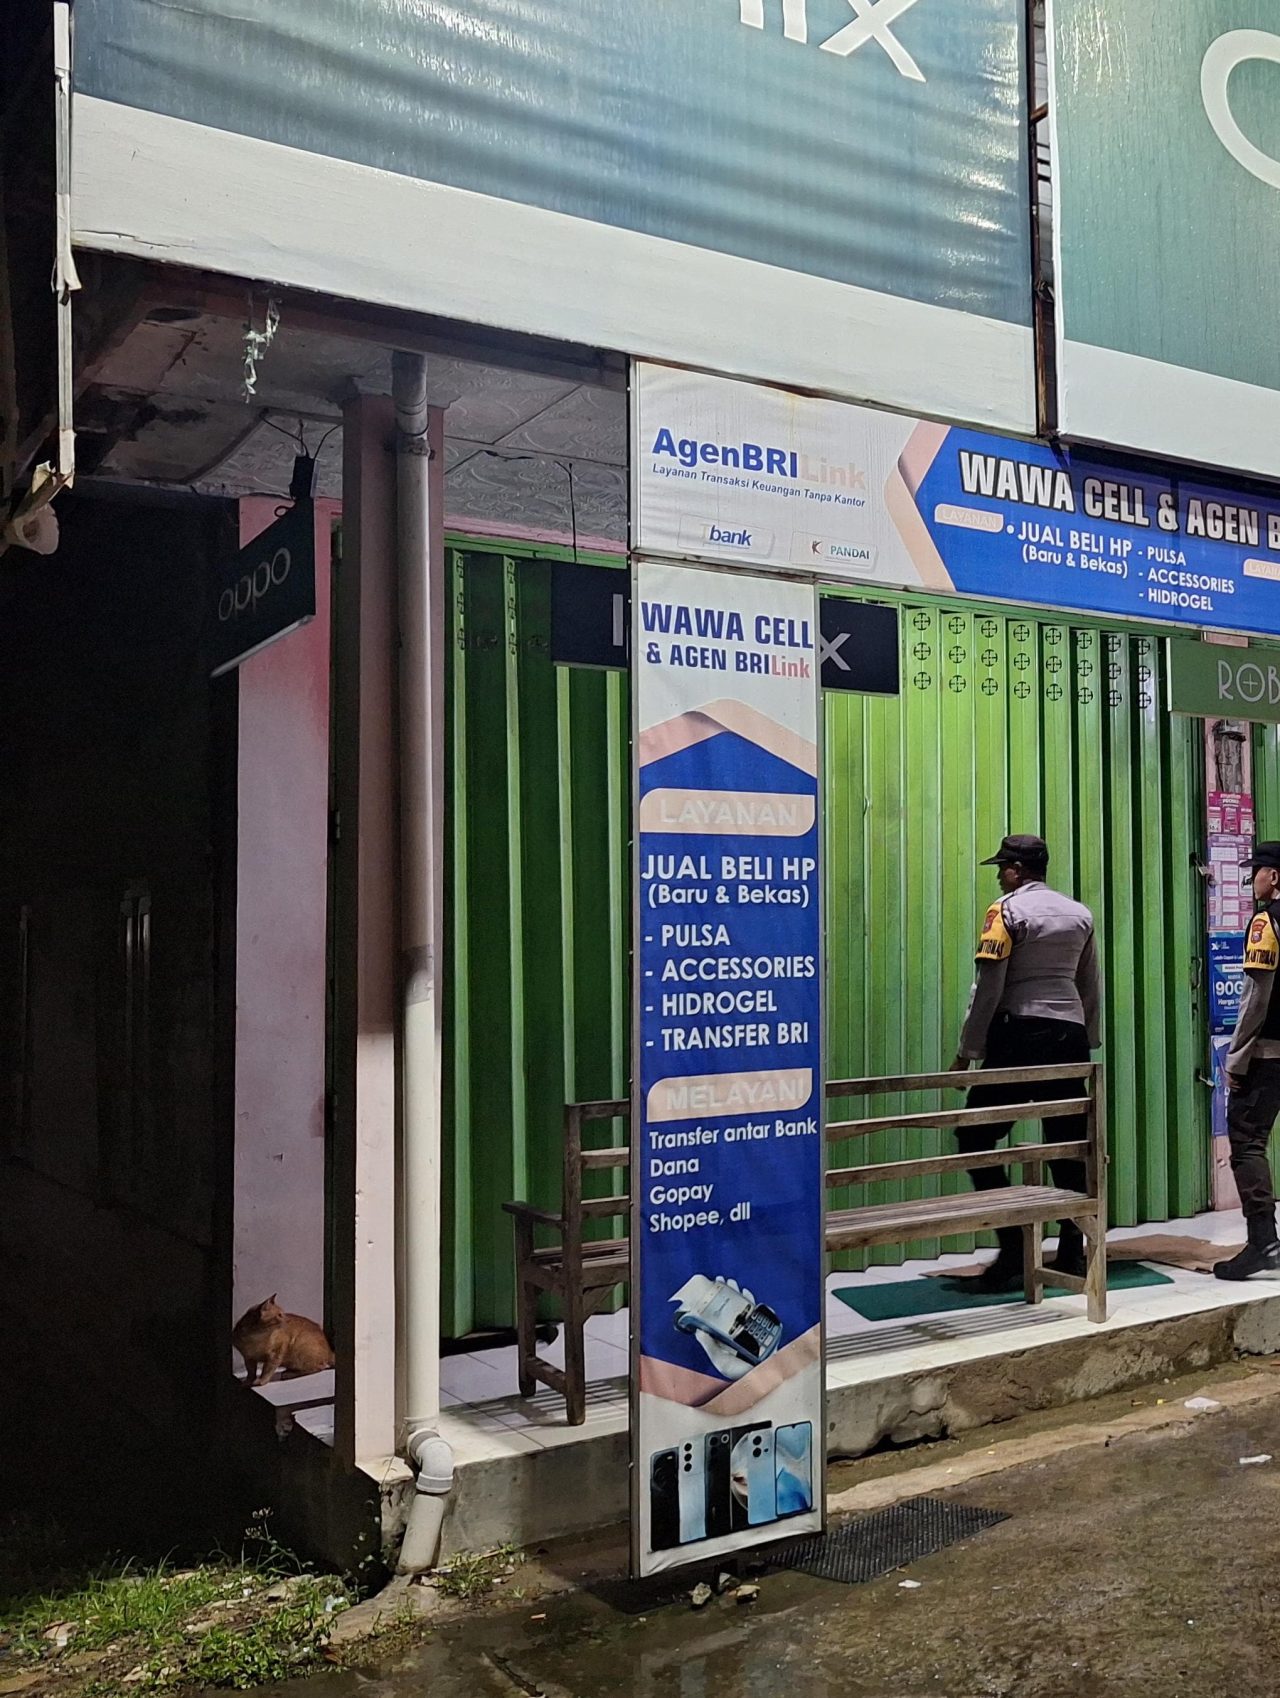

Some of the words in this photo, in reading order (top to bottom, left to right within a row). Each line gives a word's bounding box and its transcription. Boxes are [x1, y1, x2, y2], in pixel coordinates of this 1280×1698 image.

[652, 463, 697, 479] Layanan
[701, 471, 750, 488] Transaksi
[752, 480, 801, 498] Keuangan
[803, 489, 832, 503] Tanpa
[834, 494, 866, 508] Kantor
[959, 450, 1076, 513] WAWA
[1083, 476, 1150, 528] CELL
[1156, 491, 1180, 533] &
[1186, 498, 1259, 546] AGEN
[941, 507, 997, 529] LAYANAN
[830, 545, 870, 560] PANDAI
[1018, 521, 1064, 547] JUAL
[1069, 530, 1104, 554] BELI
[1109, 537, 1133, 558] HP
[1022, 544, 1062, 564] (Baru
[1066, 552, 1076, 568] &
[1080, 554, 1129, 579] Bekas)
[1147, 546, 1186, 567] PULSA
[218, 547, 291, 621] oppo
[1148, 567, 1235, 594] ACCESSORIES
[1148, 587, 1214, 611] HIDROGEL
[641, 602, 745, 642] WAWA
[754, 613, 814, 649] CELL
[646, 642, 662, 665] &
[670, 644, 727, 671] AGEN
[735, 650, 810, 679] BRILink
[660, 799, 798, 826] LAYANAN
[641, 855, 712, 880] JUAL
[721, 856, 773, 880] BELI
[782, 857, 816, 880] HP
[648, 883, 708, 909] (Baru
[715, 885, 730, 904] &
[738, 884, 809, 908] Bekas)
[661, 924, 731, 947] PULSA
[661, 955, 815, 982] ACCESSORIES
[662, 990, 777, 1017] HIDROGEL
[661, 1023, 770, 1052] TRANSFER
[777, 1021, 808, 1045] BRI
[666, 1078, 804, 1111] MELAYANI
[649, 1126, 720, 1150] Transfer
[724, 1122, 771, 1142] antar
[775, 1117, 817, 1138] Bank
[650, 1158, 700, 1178] Dana
[650, 1184, 714, 1206] Gopay
[649, 1209, 725, 1233] Shopee,
[730, 1201, 751, 1223] dll
